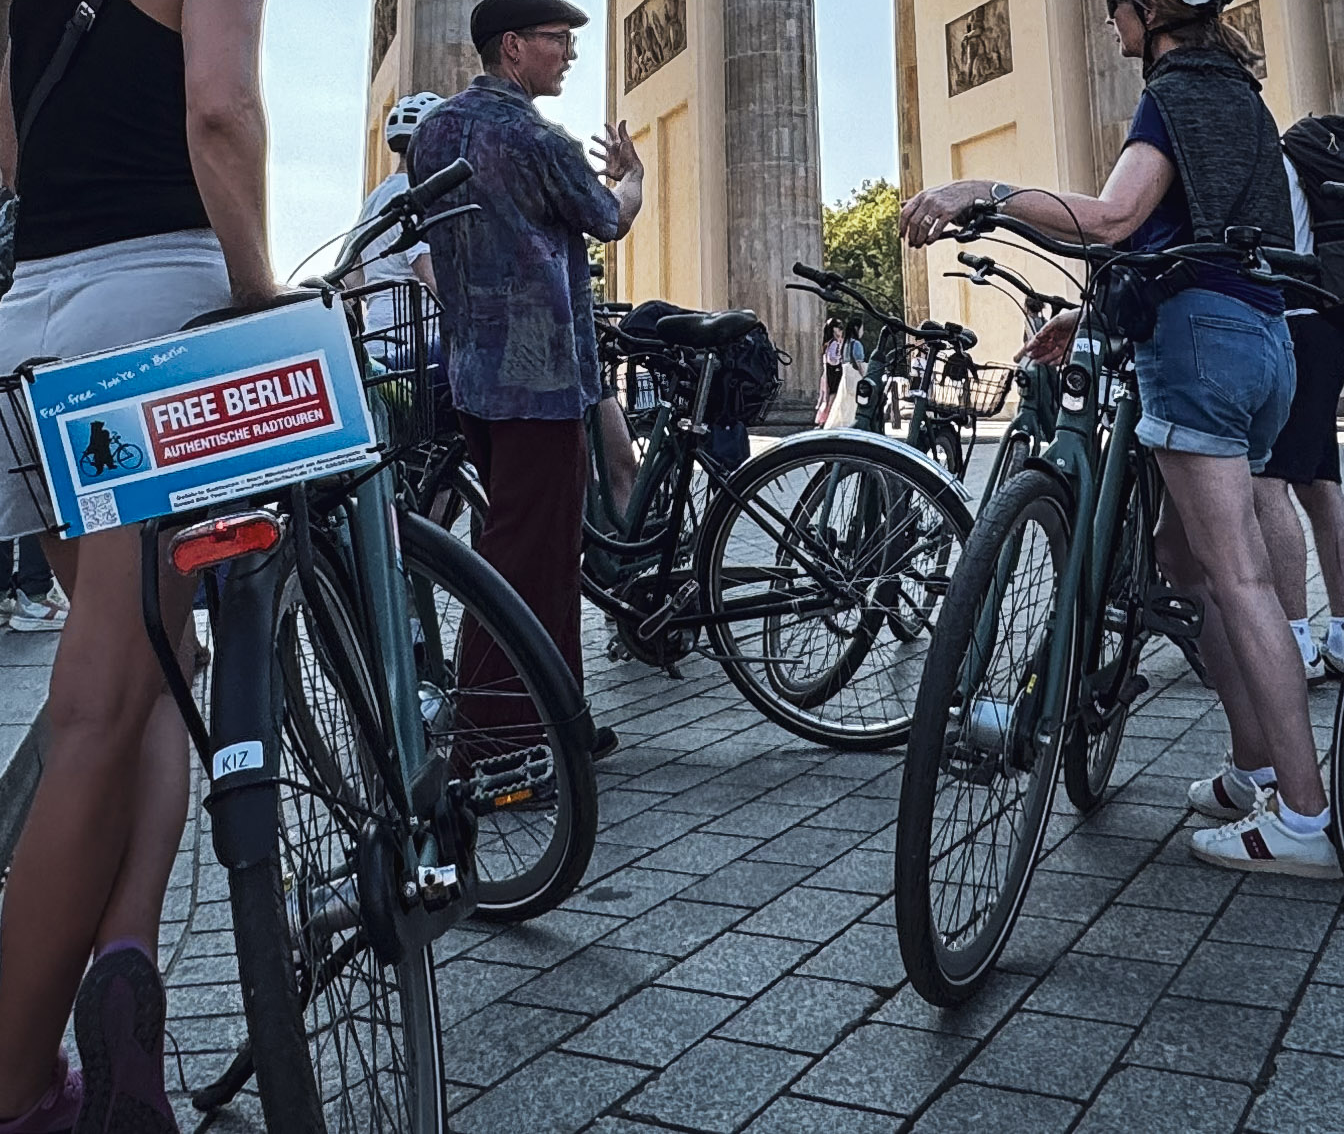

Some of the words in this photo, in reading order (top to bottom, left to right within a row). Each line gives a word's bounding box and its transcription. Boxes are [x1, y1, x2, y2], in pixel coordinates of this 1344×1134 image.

[68, 390, 96, 405] free
[152, 392, 220, 434] FREE
[222, 368, 317, 416] BERLIN
[164, 426, 251, 459] AUTHENTISCHE
[253, 408, 324, 436] RADTOUREN
